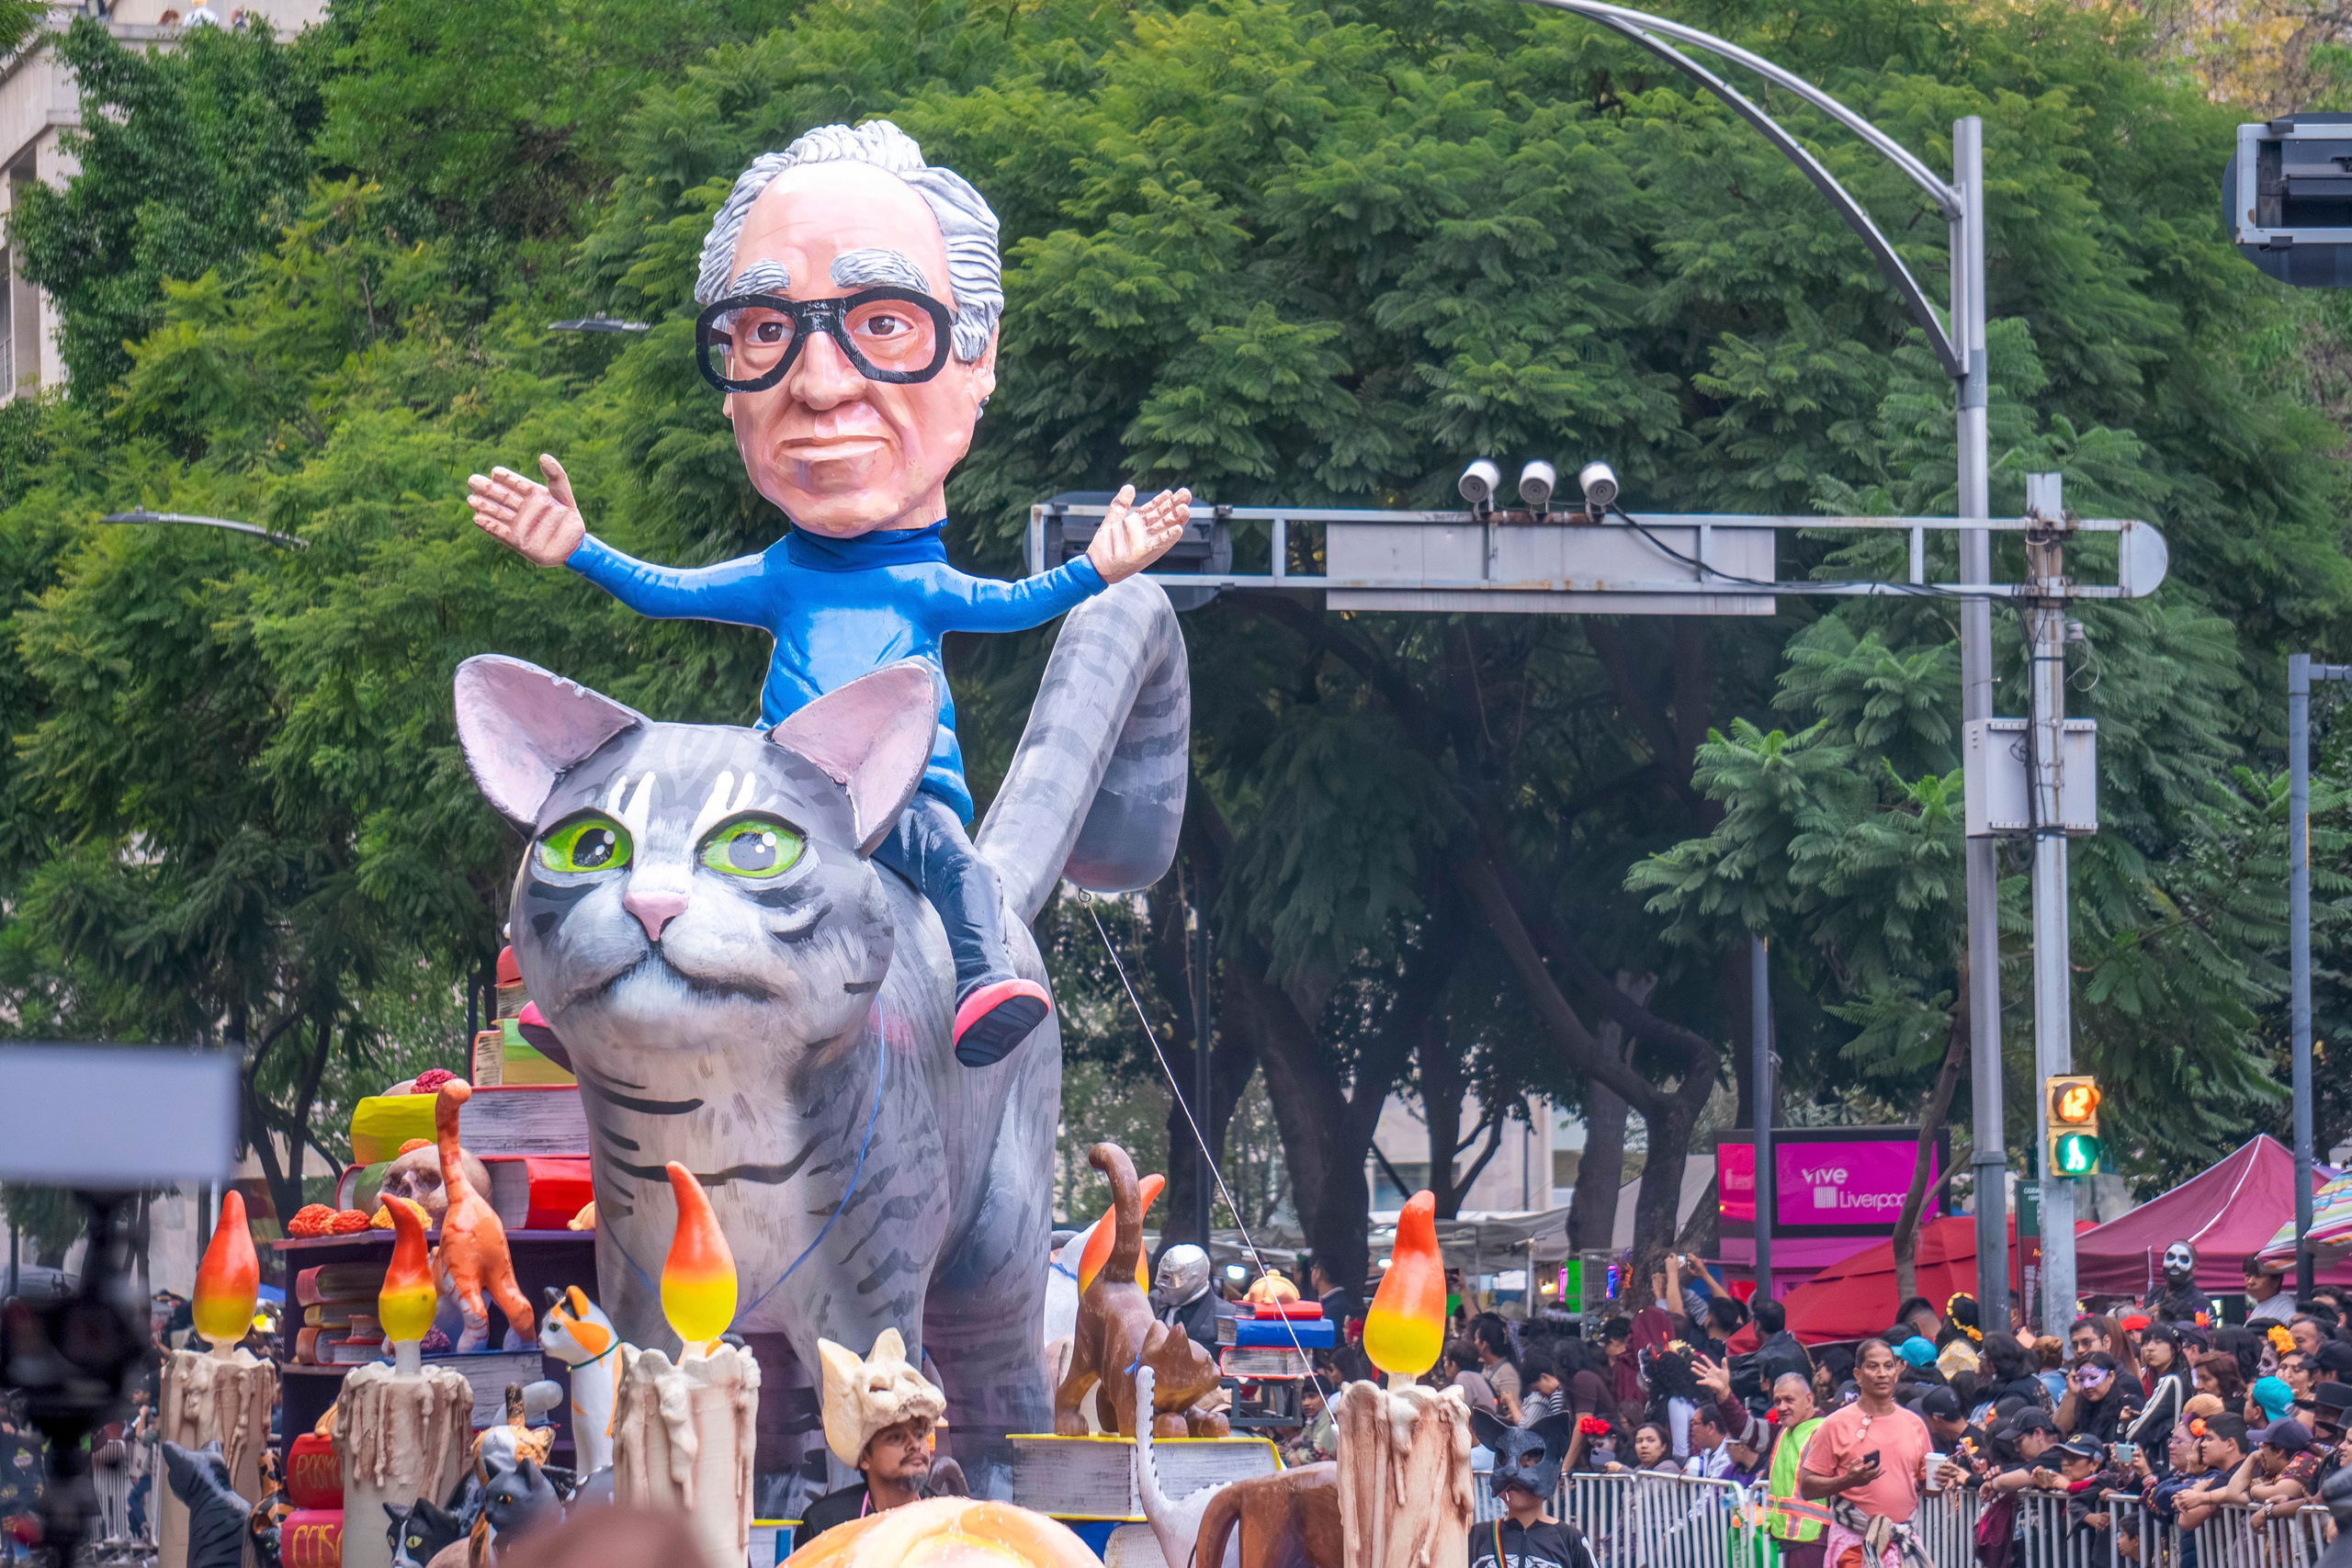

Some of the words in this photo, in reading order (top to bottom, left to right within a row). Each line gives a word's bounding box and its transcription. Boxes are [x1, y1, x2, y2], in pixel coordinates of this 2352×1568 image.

[2064, 1088, 2088, 1117] 12
[1802, 1168, 1849, 1184] vive
[1840, 1190, 1907, 1212] Liverpoo
